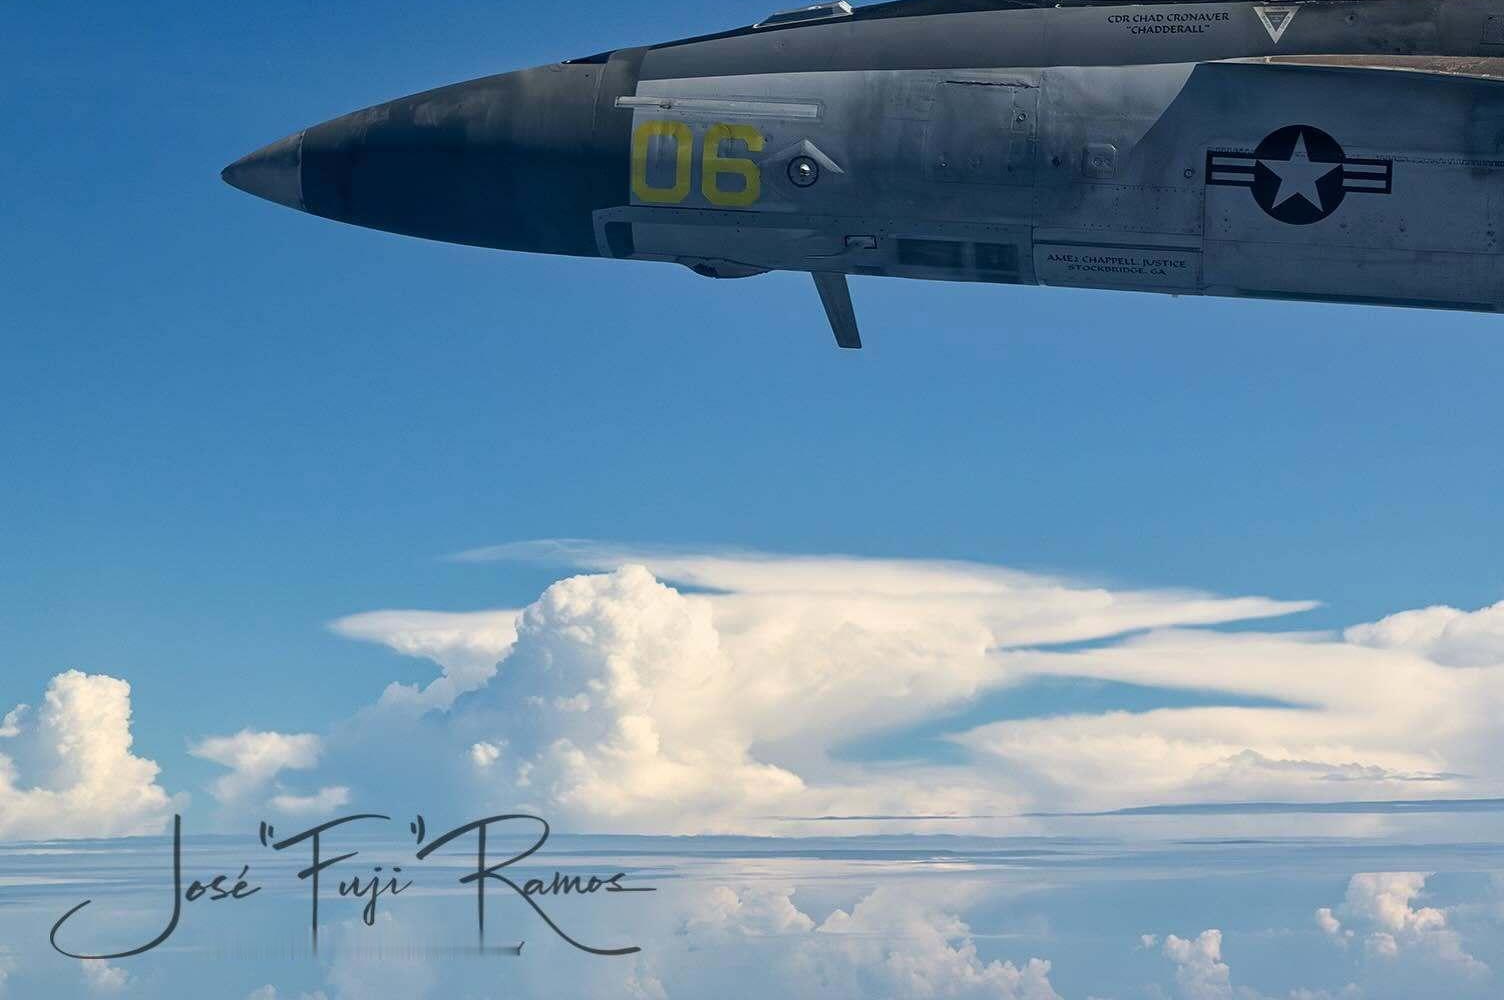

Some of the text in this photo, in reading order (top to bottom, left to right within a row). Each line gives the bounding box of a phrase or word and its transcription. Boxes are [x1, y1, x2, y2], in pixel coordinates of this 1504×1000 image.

[1107, 14, 1130, 24] CDR
[1132, 13, 1164, 23] CHAD
[630, 119, 765, 207] 06
